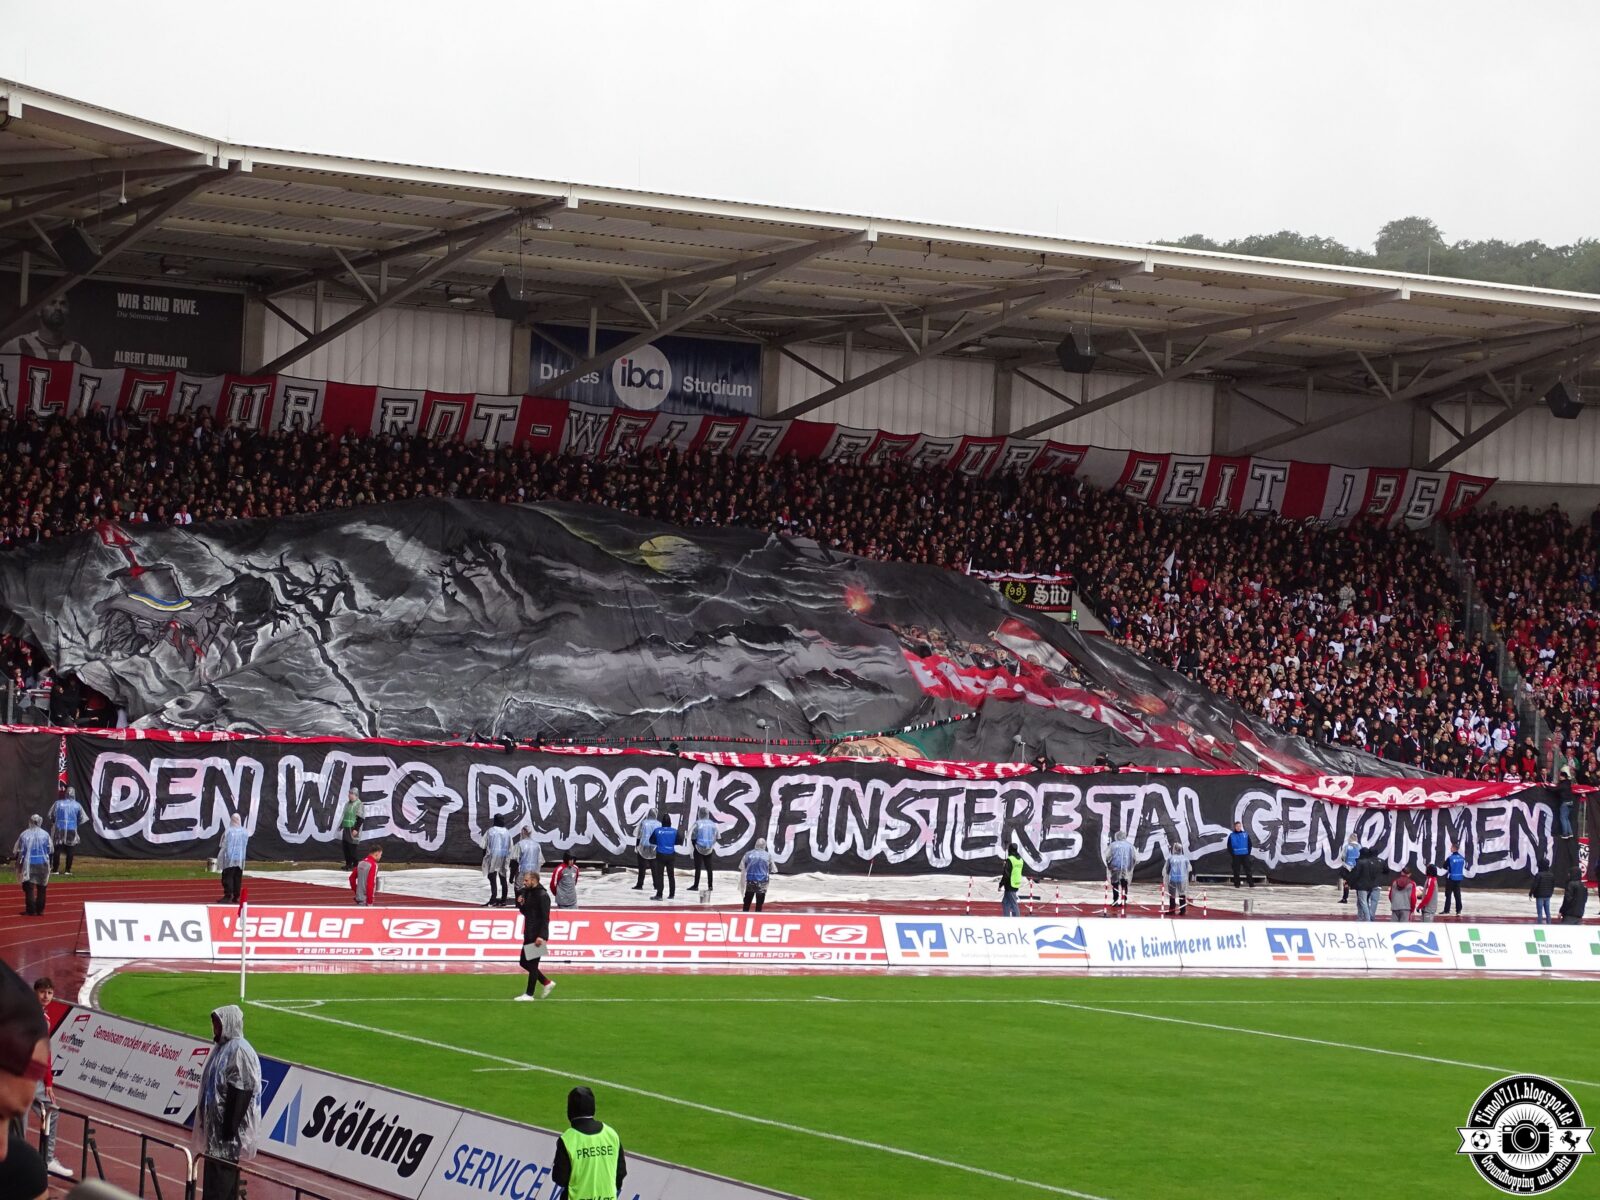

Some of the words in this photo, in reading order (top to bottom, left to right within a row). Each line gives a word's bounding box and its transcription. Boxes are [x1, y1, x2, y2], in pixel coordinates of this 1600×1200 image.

[116, 292, 140, 310] WIR
[142, 295, 170, 313] SIND
[172, 297, 200, 316] RWE.
[114, 350, 145, 365] ALBERT
[147, 353, 188, 369] BUNJAKU
[621, 357, 664, 389] iba
[540, 362, 600, 384] Dues
[682, 376, 753, 398] Studium
[1122, 458, 1288, 512] SEIT
[1009, 586, 1022, 596] 98
[1032, 583, 1070, 606] Süd
[90, 752, 264, 845] DEN
[277, 750, 464, 852] WEG
[769, 774, 1083, 872] FINSTERE
[1086, 782, 1231, 864] TAL
[1234, 788, 1554, 877] GENOMMEN
[467, 914, 590, 941] saler
[949, 927, 1030, 945] VR-Bank
[1314, 931, 1388, 951] VR-Bank
[1107, 938, 1137, 962] Wir
[1140, 935, 1212, 958] kümmern
[1216, 925, 1247, 951] uns!
[301, 1095, 434, 1178] Stölting
[576, 1145, 614, 1160] PRESSE
[444, 1144, 552, 1200] SERVICE
